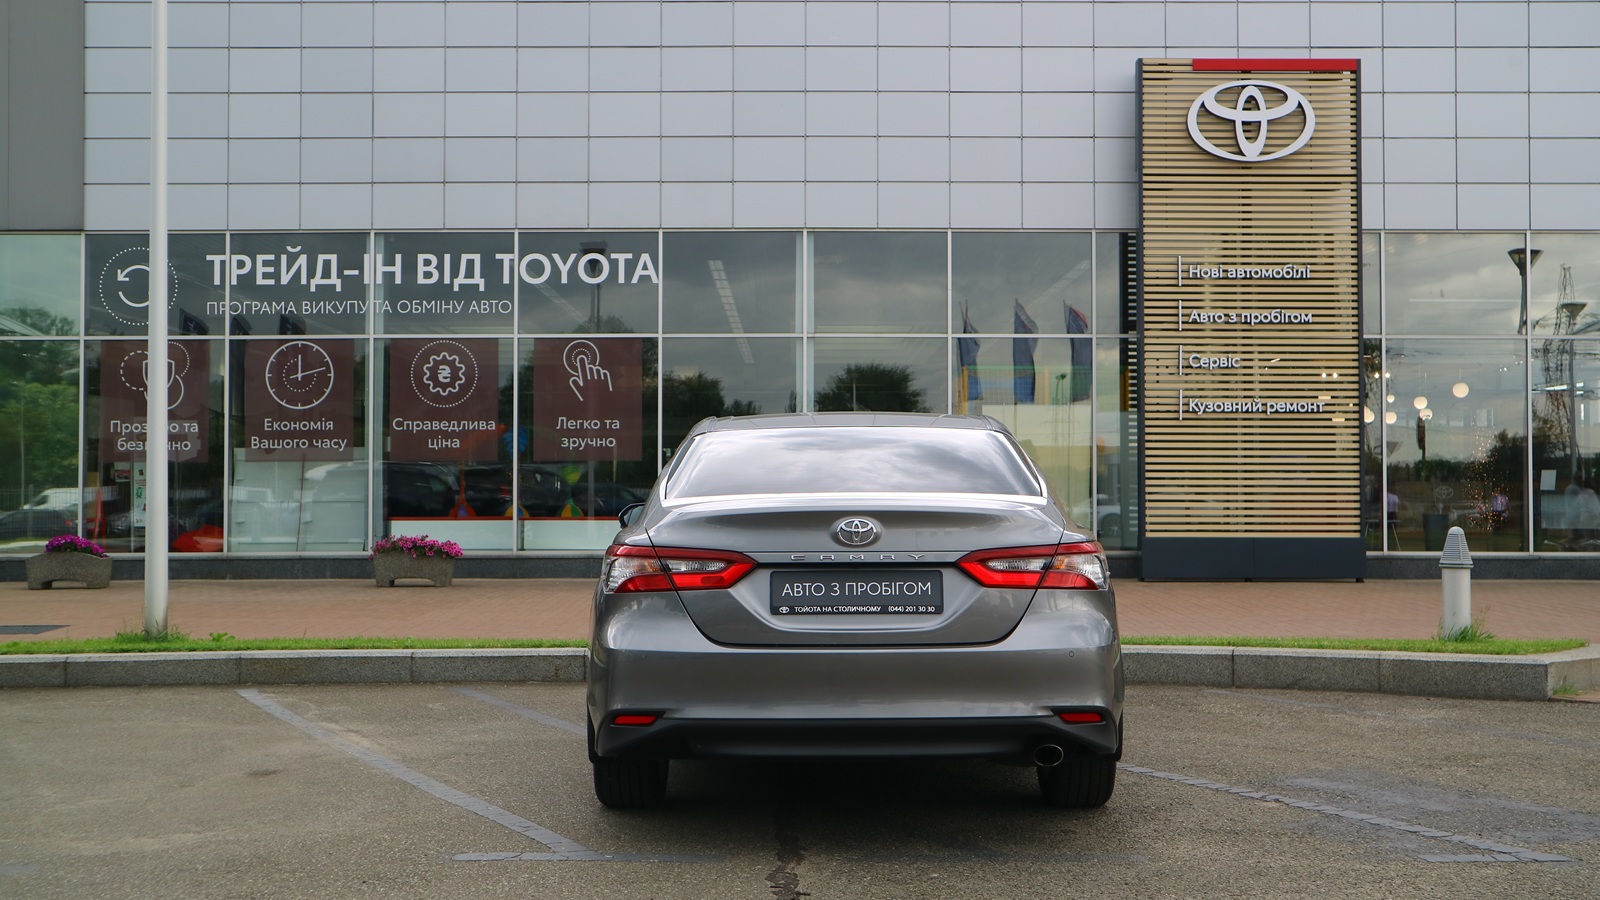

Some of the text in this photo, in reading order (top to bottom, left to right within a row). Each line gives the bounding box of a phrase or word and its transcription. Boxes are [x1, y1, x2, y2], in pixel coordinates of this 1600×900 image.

[206, 245, 659, 292] ТРЕЙД-ІН ВІД TOYOTA
[1188, 264, 1311, 279] Нові автомобілі
[206, 299, 512, 315] ПРОГРАМА ВИКУПУ ТА ОБМІНУ АВТО
[1188, 309, 1313, 326] Авто з пробігом
[1188, 354, 1241, 370] Сервіс
[1188, 398, 1326, 415] Кузовний ремонт
[110, 420, 199, 436] Прозо та
[264, 419, 334, 431] Економія
[392, 418, 496, 432] Справедлива
[556, 417, 620, 430] Легко та
[251, 437, 348, 451] Вашого часу
[428, 436, 460, 449] ціна
[561, 437, 616, 450] зручно
[790, 553, 926, 561] CAMRY
[781, 582, 932, 597] АВТО З ПРОБІГОМ
[794, 605, 935, 613] ТОЙОТА НА СТОЛИЧНОМУ (044) 201 30 30
